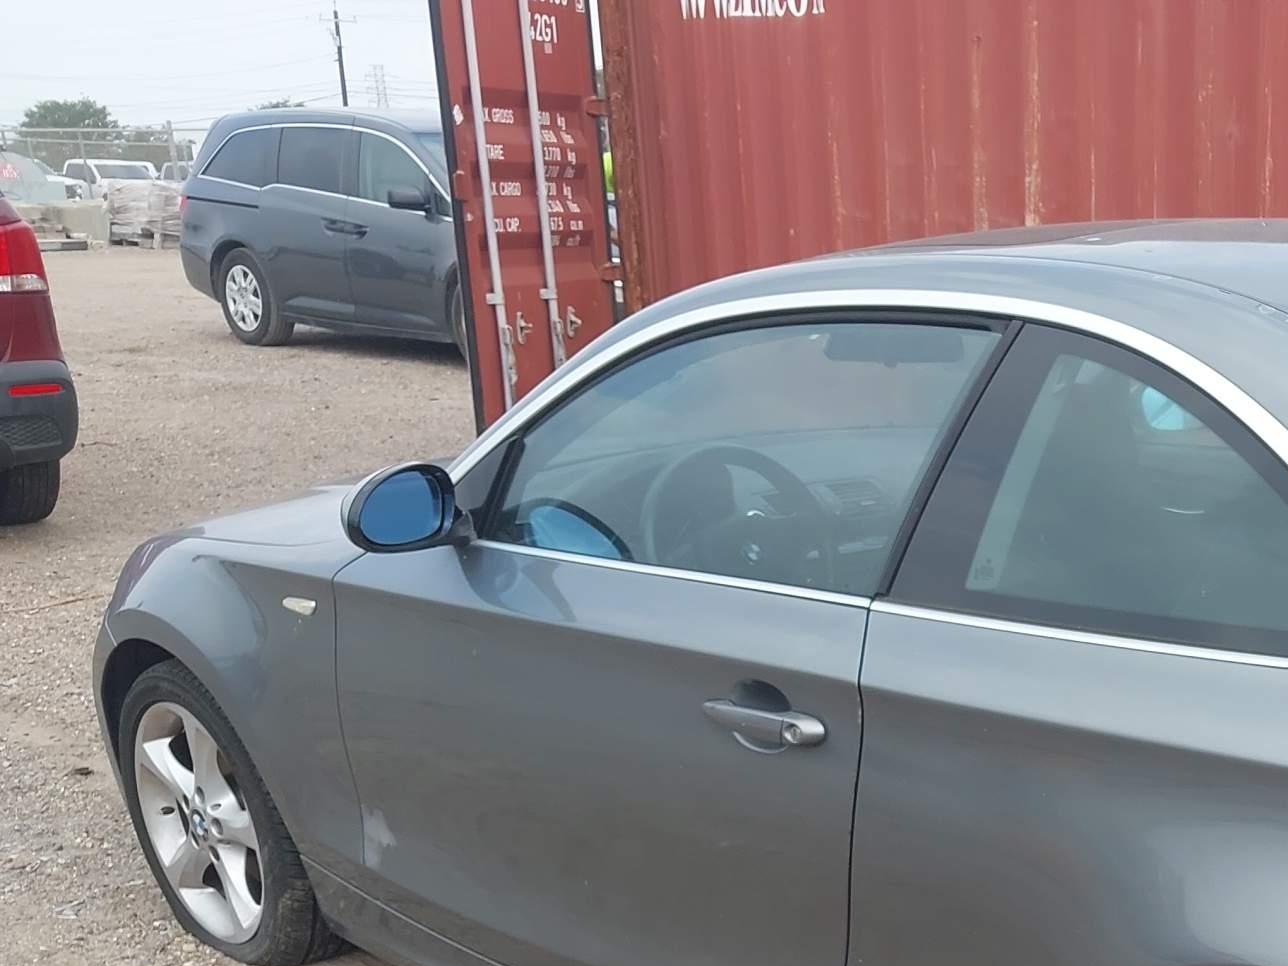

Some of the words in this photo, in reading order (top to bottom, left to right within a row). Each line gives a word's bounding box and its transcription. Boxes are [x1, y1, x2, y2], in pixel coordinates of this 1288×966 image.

[491, 108, 514, 124] GROSS
[485, 144, 504, 160] TARE
[500, 182, 521, 196] CARGO
